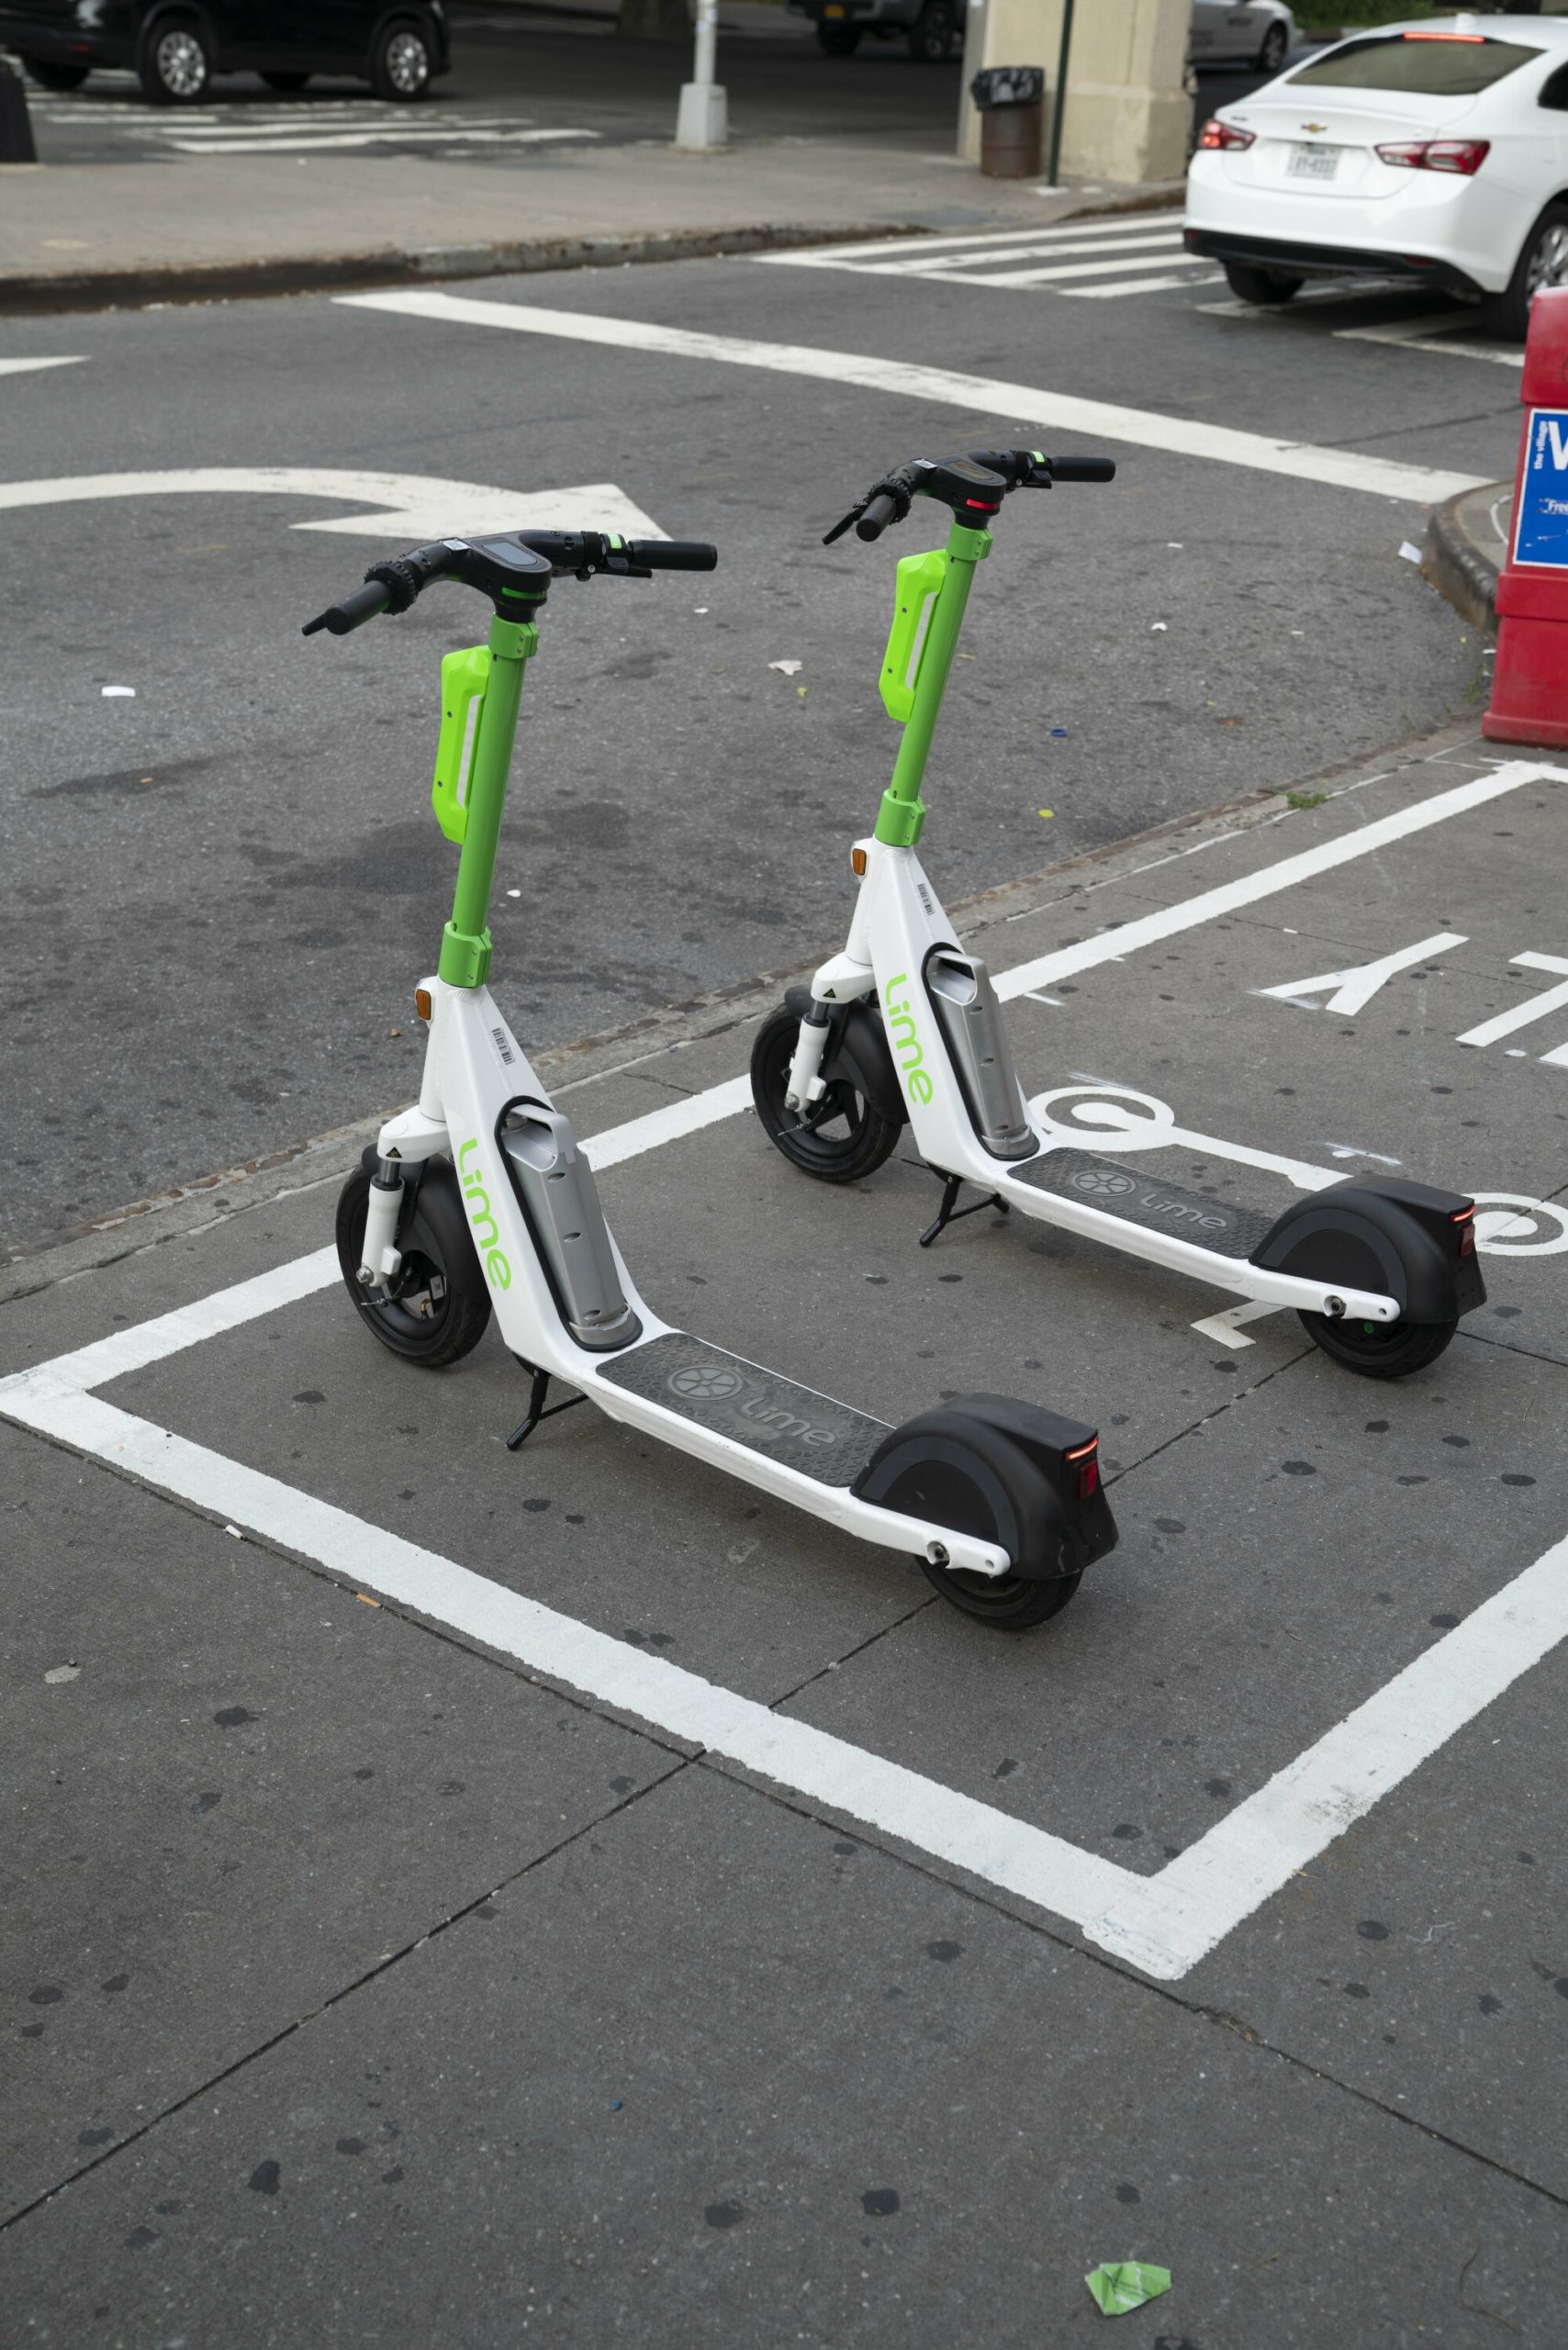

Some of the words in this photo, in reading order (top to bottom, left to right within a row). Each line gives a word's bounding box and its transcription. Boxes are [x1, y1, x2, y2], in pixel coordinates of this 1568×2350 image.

[886, 973, 933, 1105] Lime
[459, 1137, 511, 1291] Lime
[1141, 1193, 1226, 1229] Lime
[741, 1396, 835, 1447] Lime
